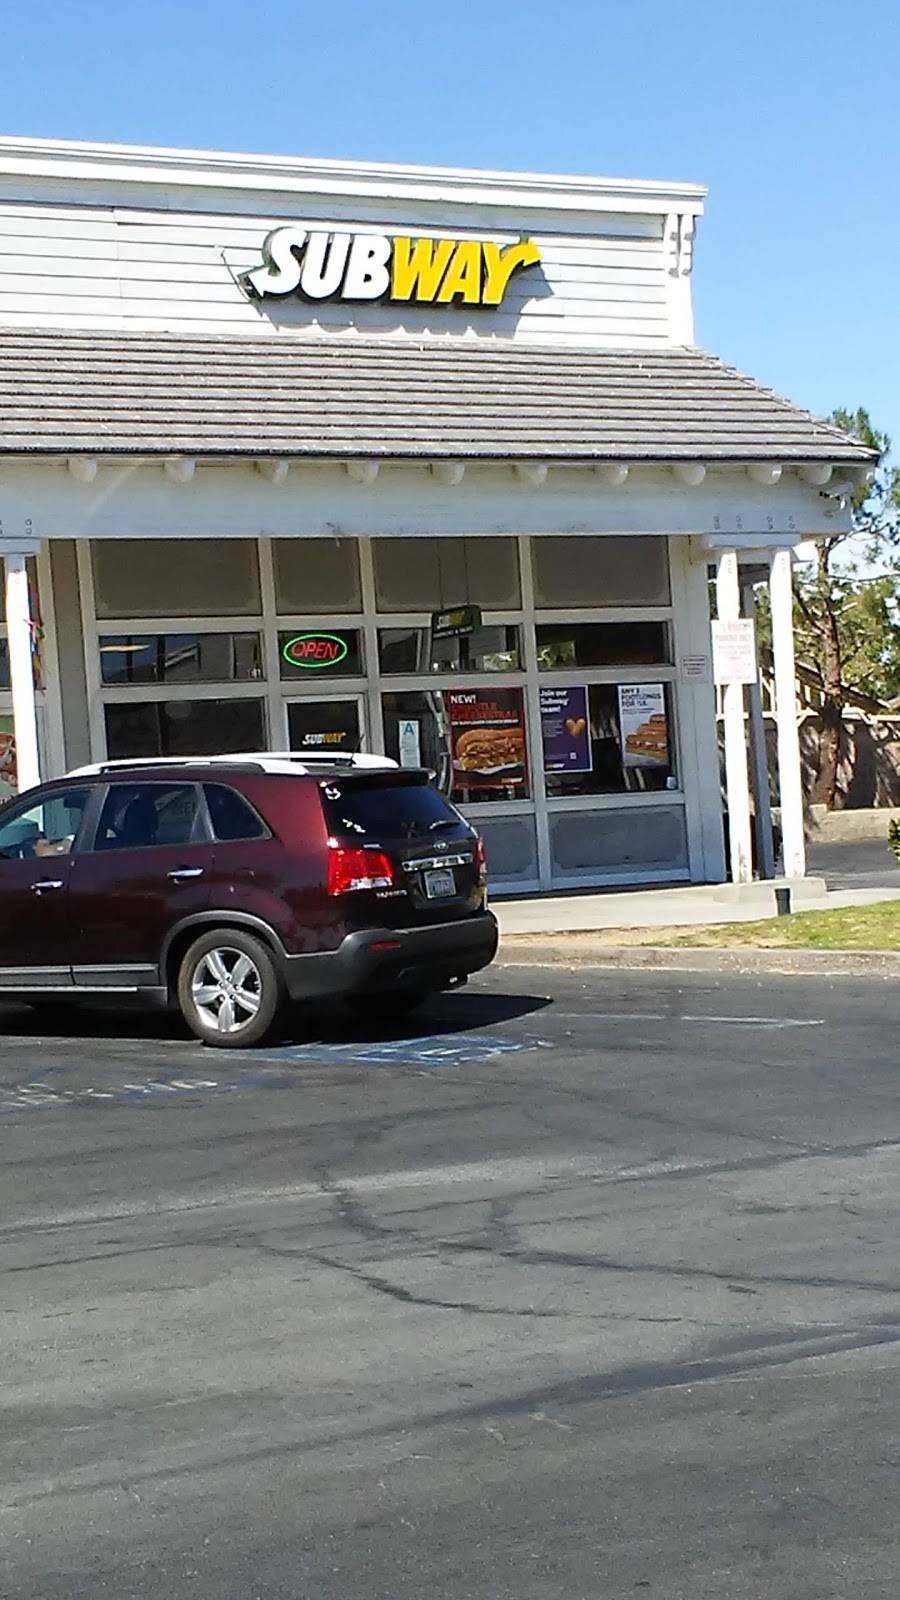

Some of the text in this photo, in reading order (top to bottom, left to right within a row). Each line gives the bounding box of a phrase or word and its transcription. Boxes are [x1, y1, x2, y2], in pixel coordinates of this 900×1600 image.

[249, 227, 541, 304] SUBWAY
[291, 641, 339, 659] OPEN
[450, 694, 477, 704] NEW!
[403, 722, 415, 735] A
